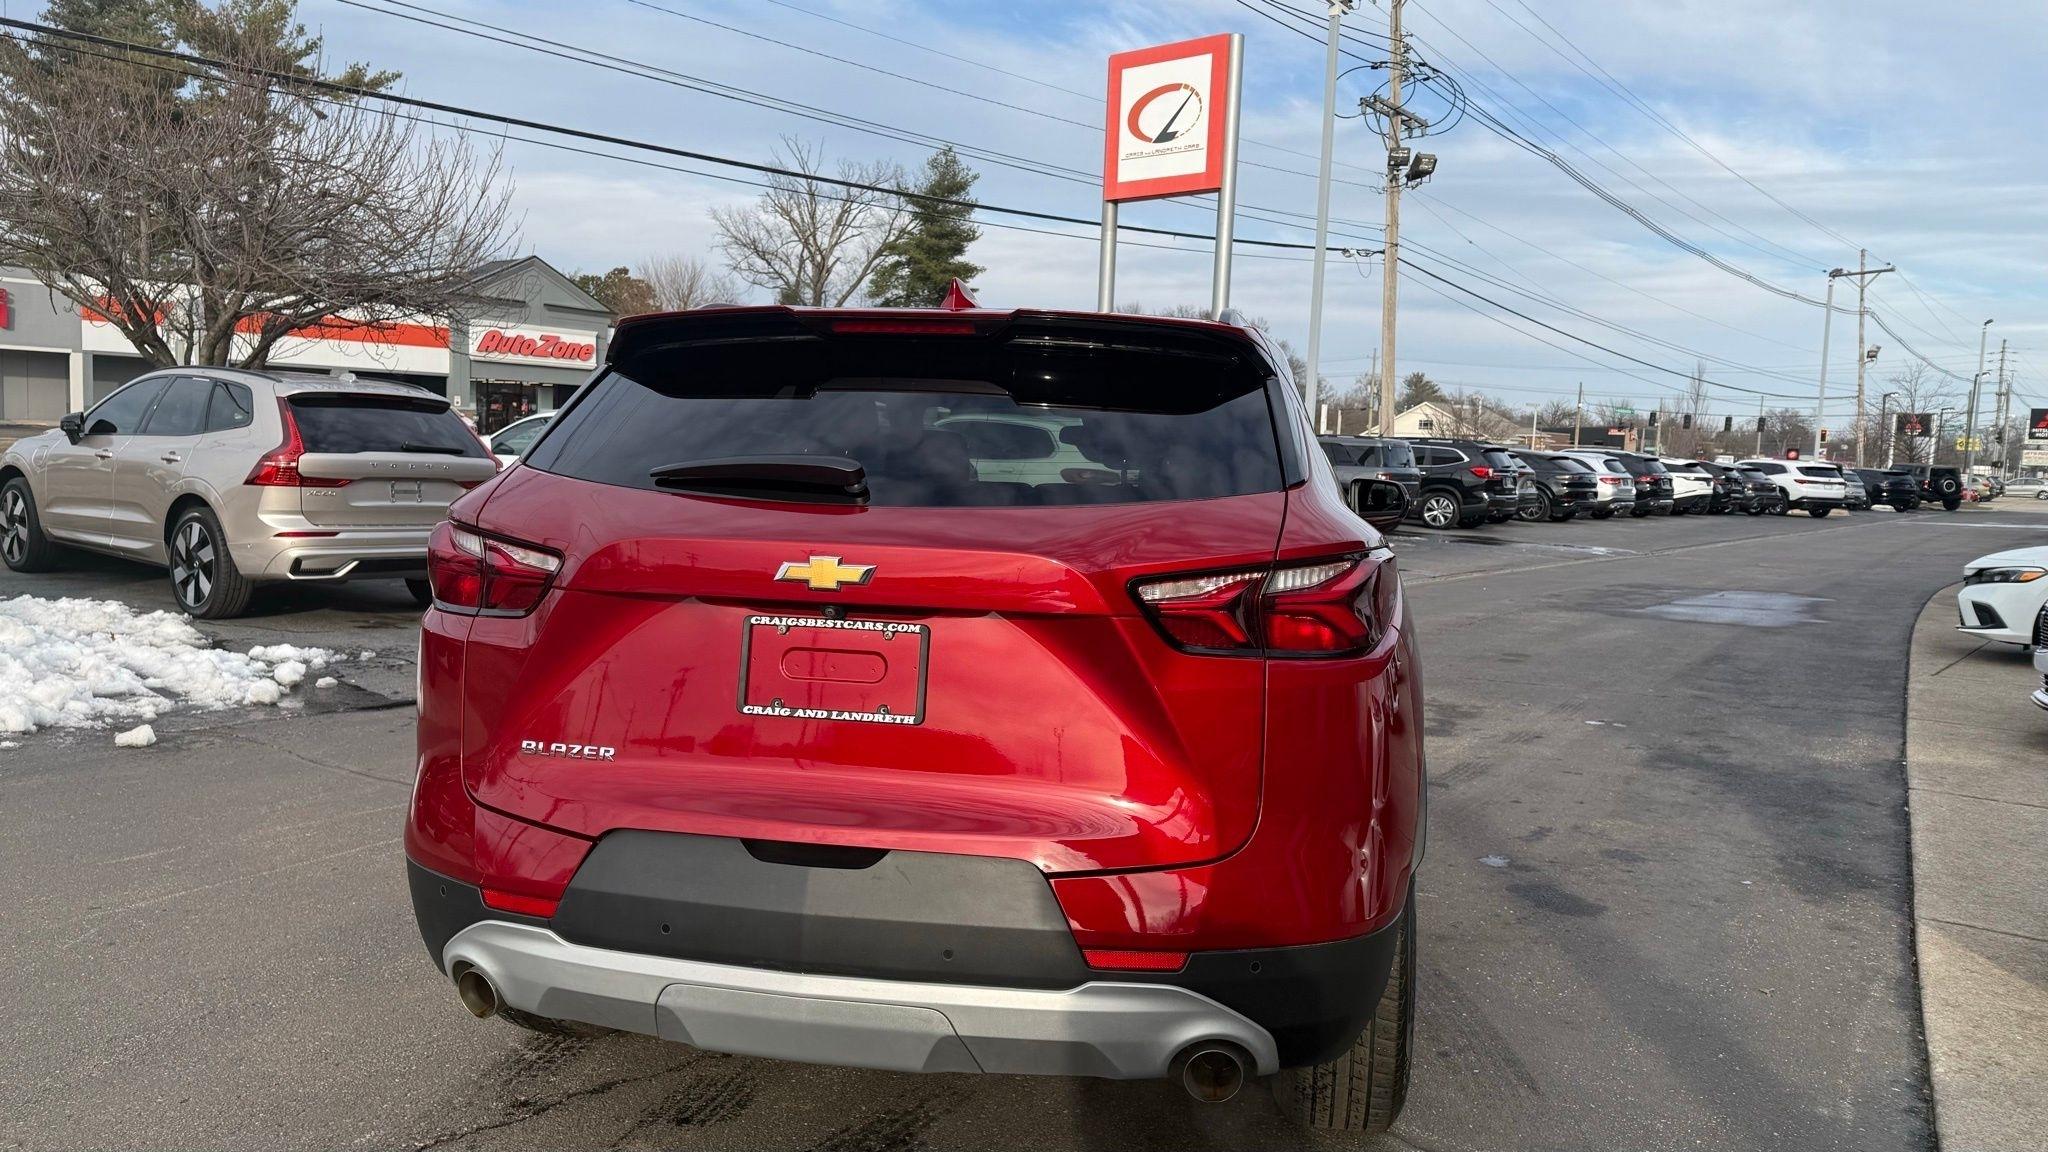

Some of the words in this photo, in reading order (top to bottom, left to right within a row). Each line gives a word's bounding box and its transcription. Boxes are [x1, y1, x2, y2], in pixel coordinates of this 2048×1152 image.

[476, 329, 595, 361] AutoZone
[750, 616, 922, 633] CRAIGSBESTCARS.COM
[742, 705, 792, 716] CRAIG
[795, 708, 828, 719] AND
[830, 711, 916, 724] LANDRETH
[521, 740, 615, 762] BLAZER
